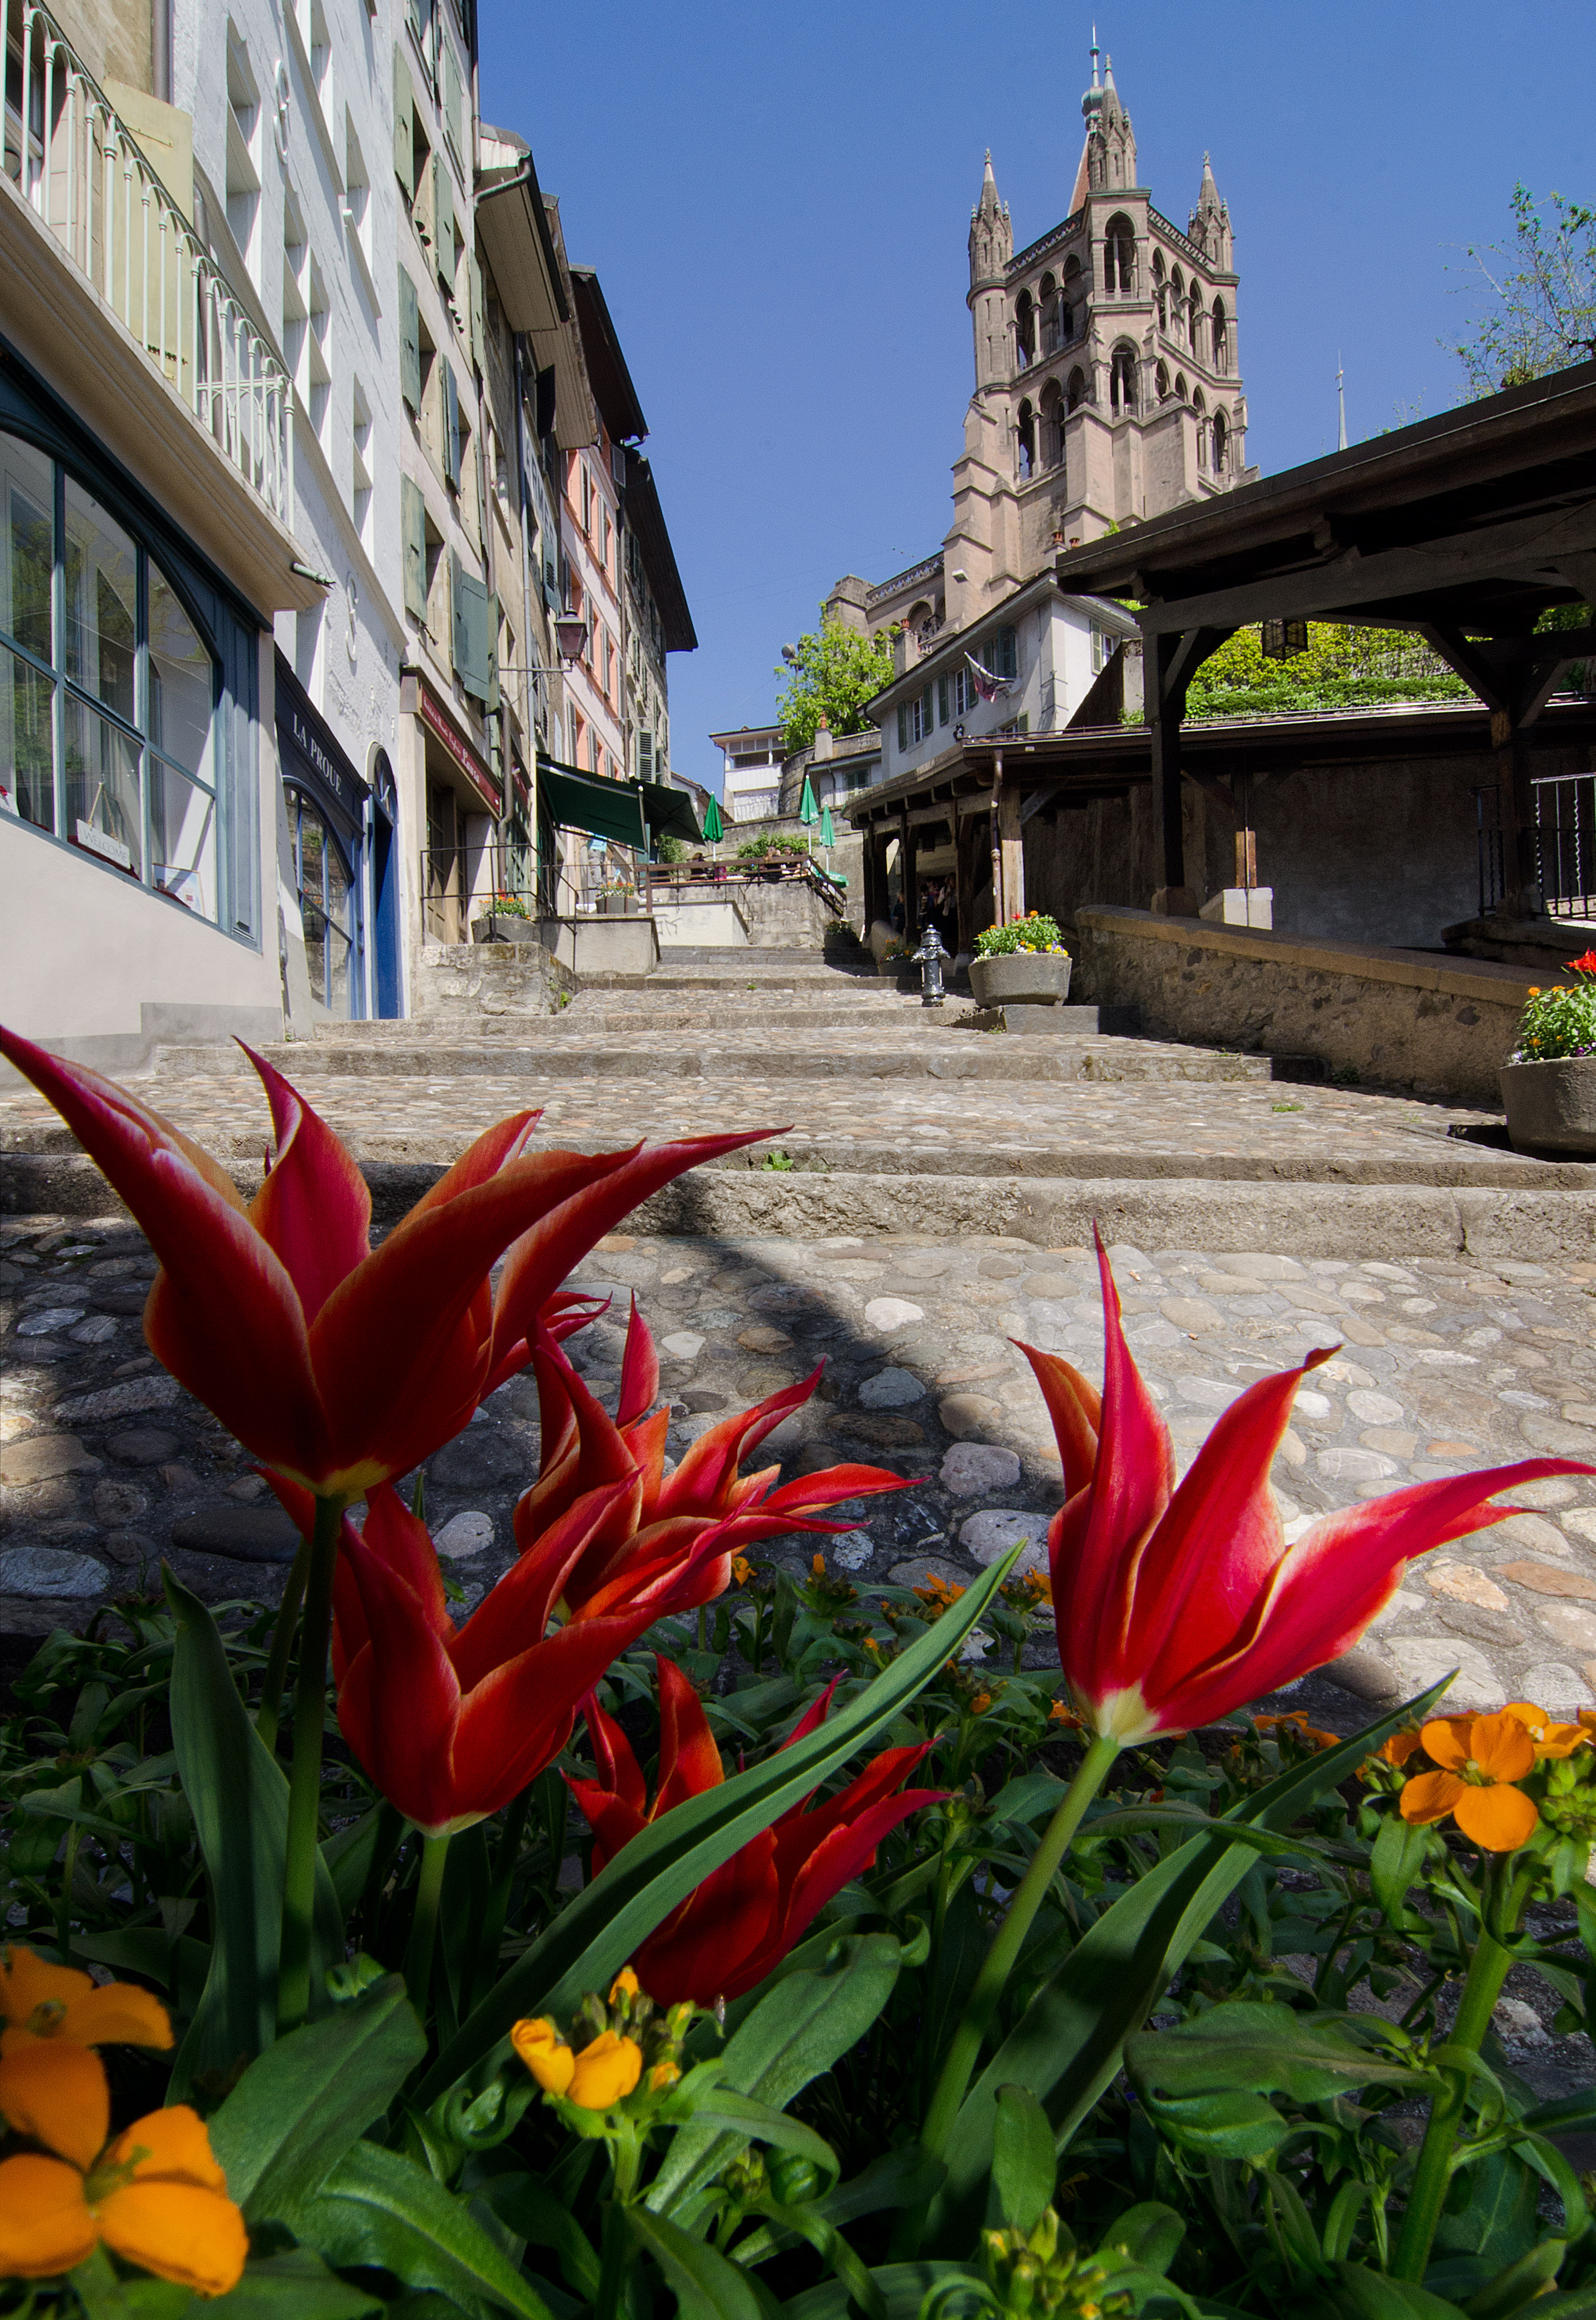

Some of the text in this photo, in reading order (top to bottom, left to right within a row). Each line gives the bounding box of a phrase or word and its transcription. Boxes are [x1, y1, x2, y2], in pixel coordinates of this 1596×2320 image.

[293, 712, 341, 796] LA PROUE
[84, 829, 128, 863] WELCOME
